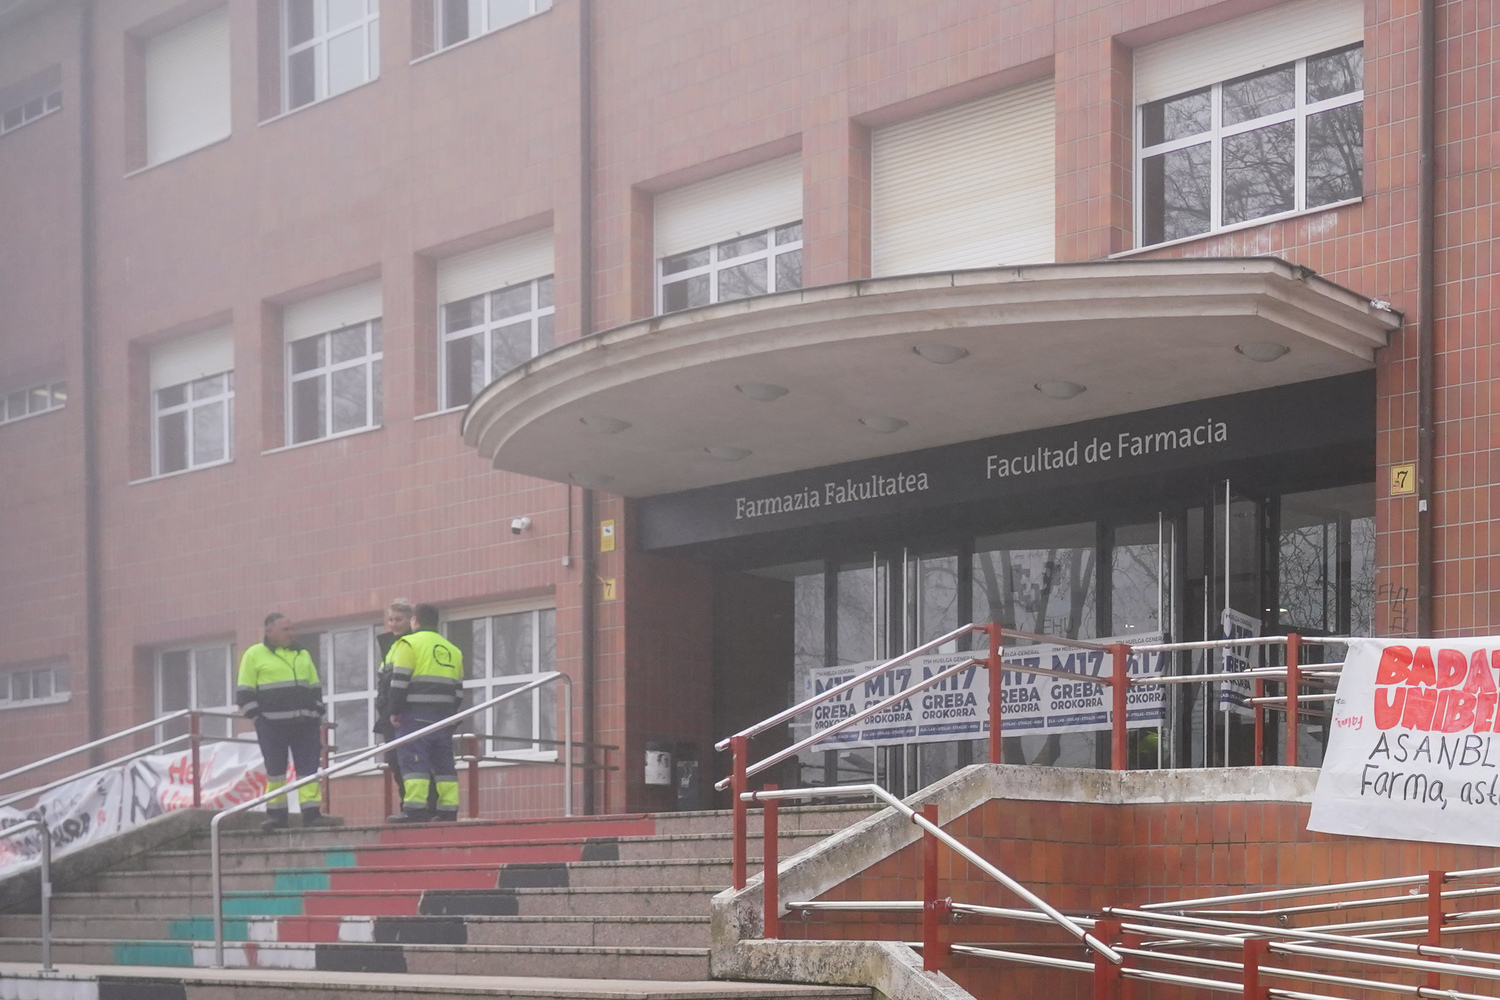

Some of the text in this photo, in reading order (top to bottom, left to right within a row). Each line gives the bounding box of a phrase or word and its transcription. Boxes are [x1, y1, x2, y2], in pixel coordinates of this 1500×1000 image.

[986, 417, 1229, 479] Facultad de Farmacia
[1397, 470, 1408, 488] 7
[735, 472, 930, 520] Farmazia Fakultatea
[1050, 683, 1104, 699] GREBA
[922, 692, 977, 710] GREBA
[1050, 698, 1103, 711] OROKORRA
[815, 704, 857, 720] GREBA
[864, 712, 913, 725] OROKORRA
[922, 709, 977, 720] OROKORRA
[1360, 763, 1448, 810] Farma,
